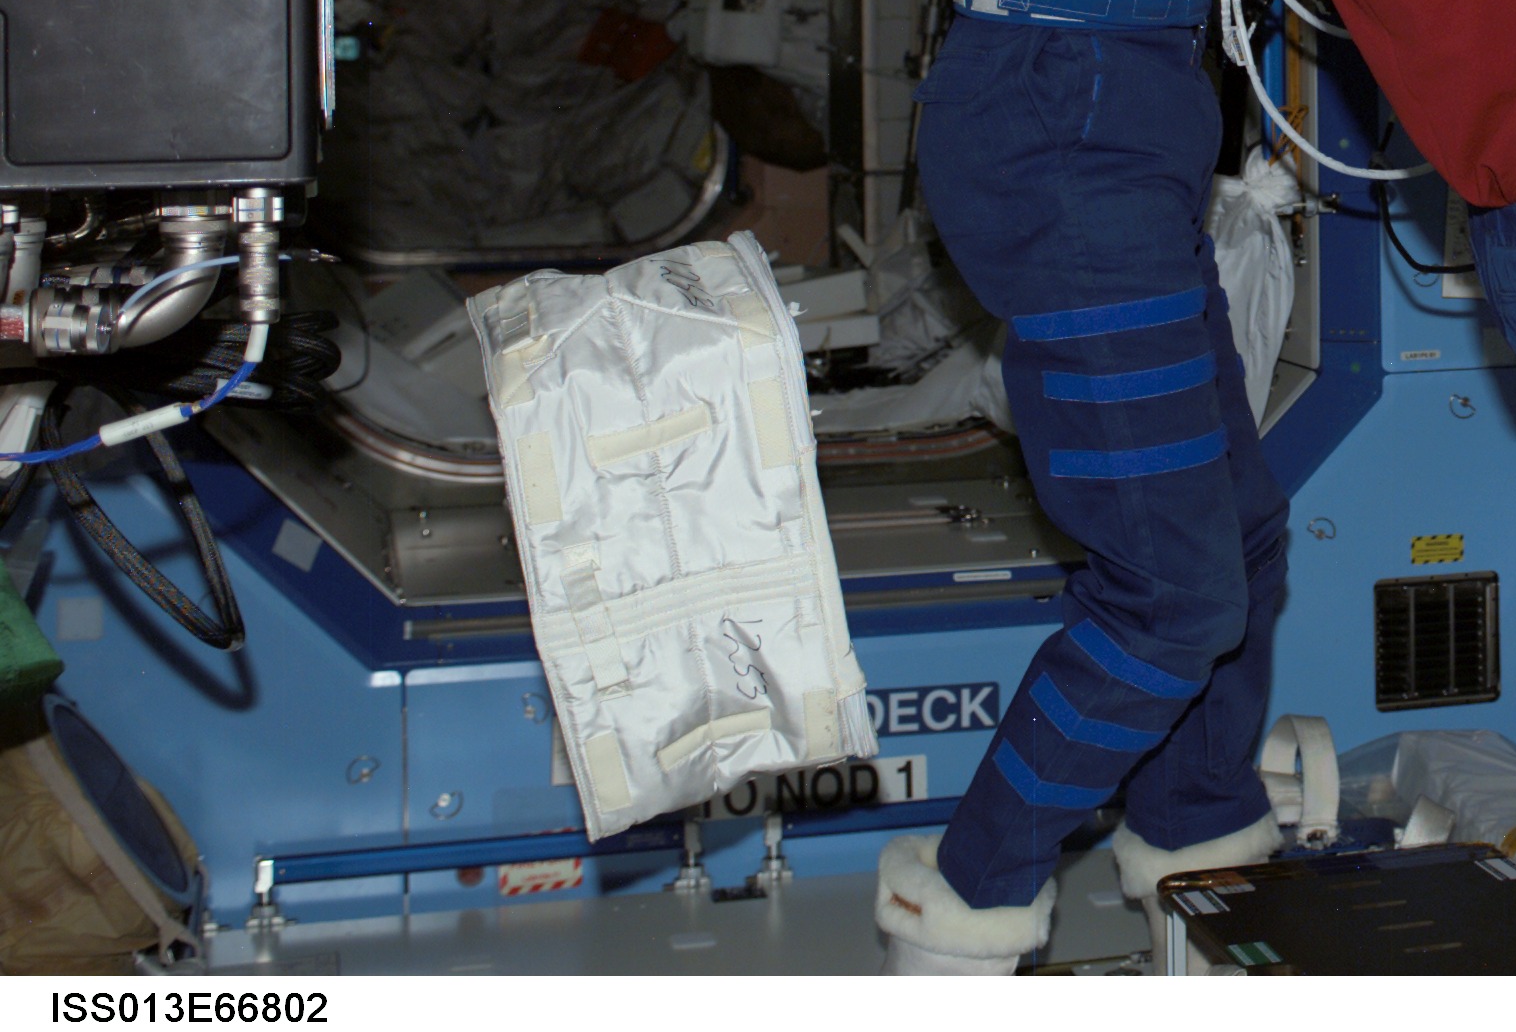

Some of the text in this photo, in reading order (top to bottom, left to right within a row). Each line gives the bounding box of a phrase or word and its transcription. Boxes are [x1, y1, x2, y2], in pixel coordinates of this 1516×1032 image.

[722, 614, 769, 700] 1253
[866, 685, 996, 735] DECK
[776, 762, 881, 816] NOD
[898, 760, 914, 799] 1
